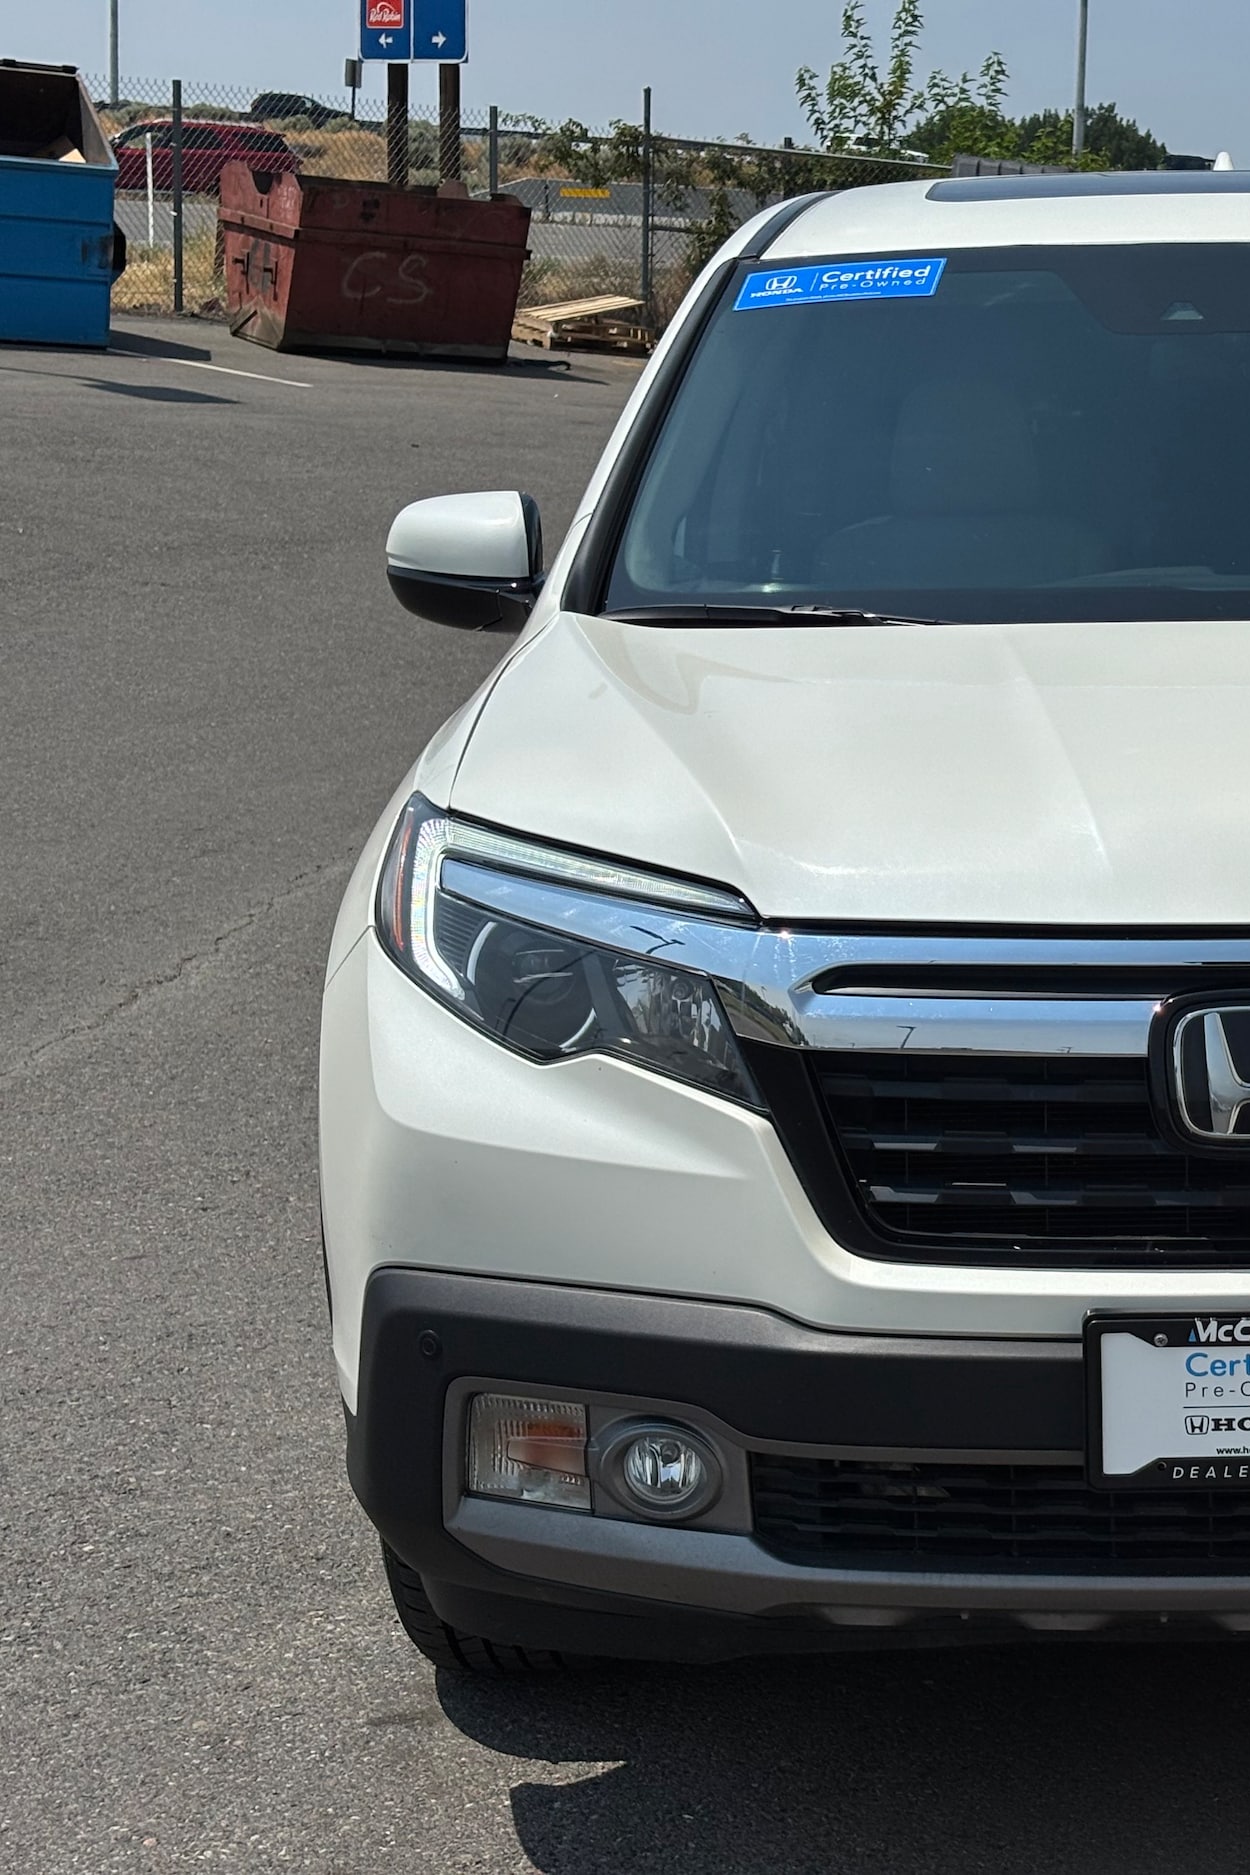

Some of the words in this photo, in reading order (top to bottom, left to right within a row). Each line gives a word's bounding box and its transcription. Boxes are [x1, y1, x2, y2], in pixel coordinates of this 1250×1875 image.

[822, 265, 931, 283] Certified
[819, 277, 926, 291] Pre-Owned
[750, 288, 804, 298] HONDA
